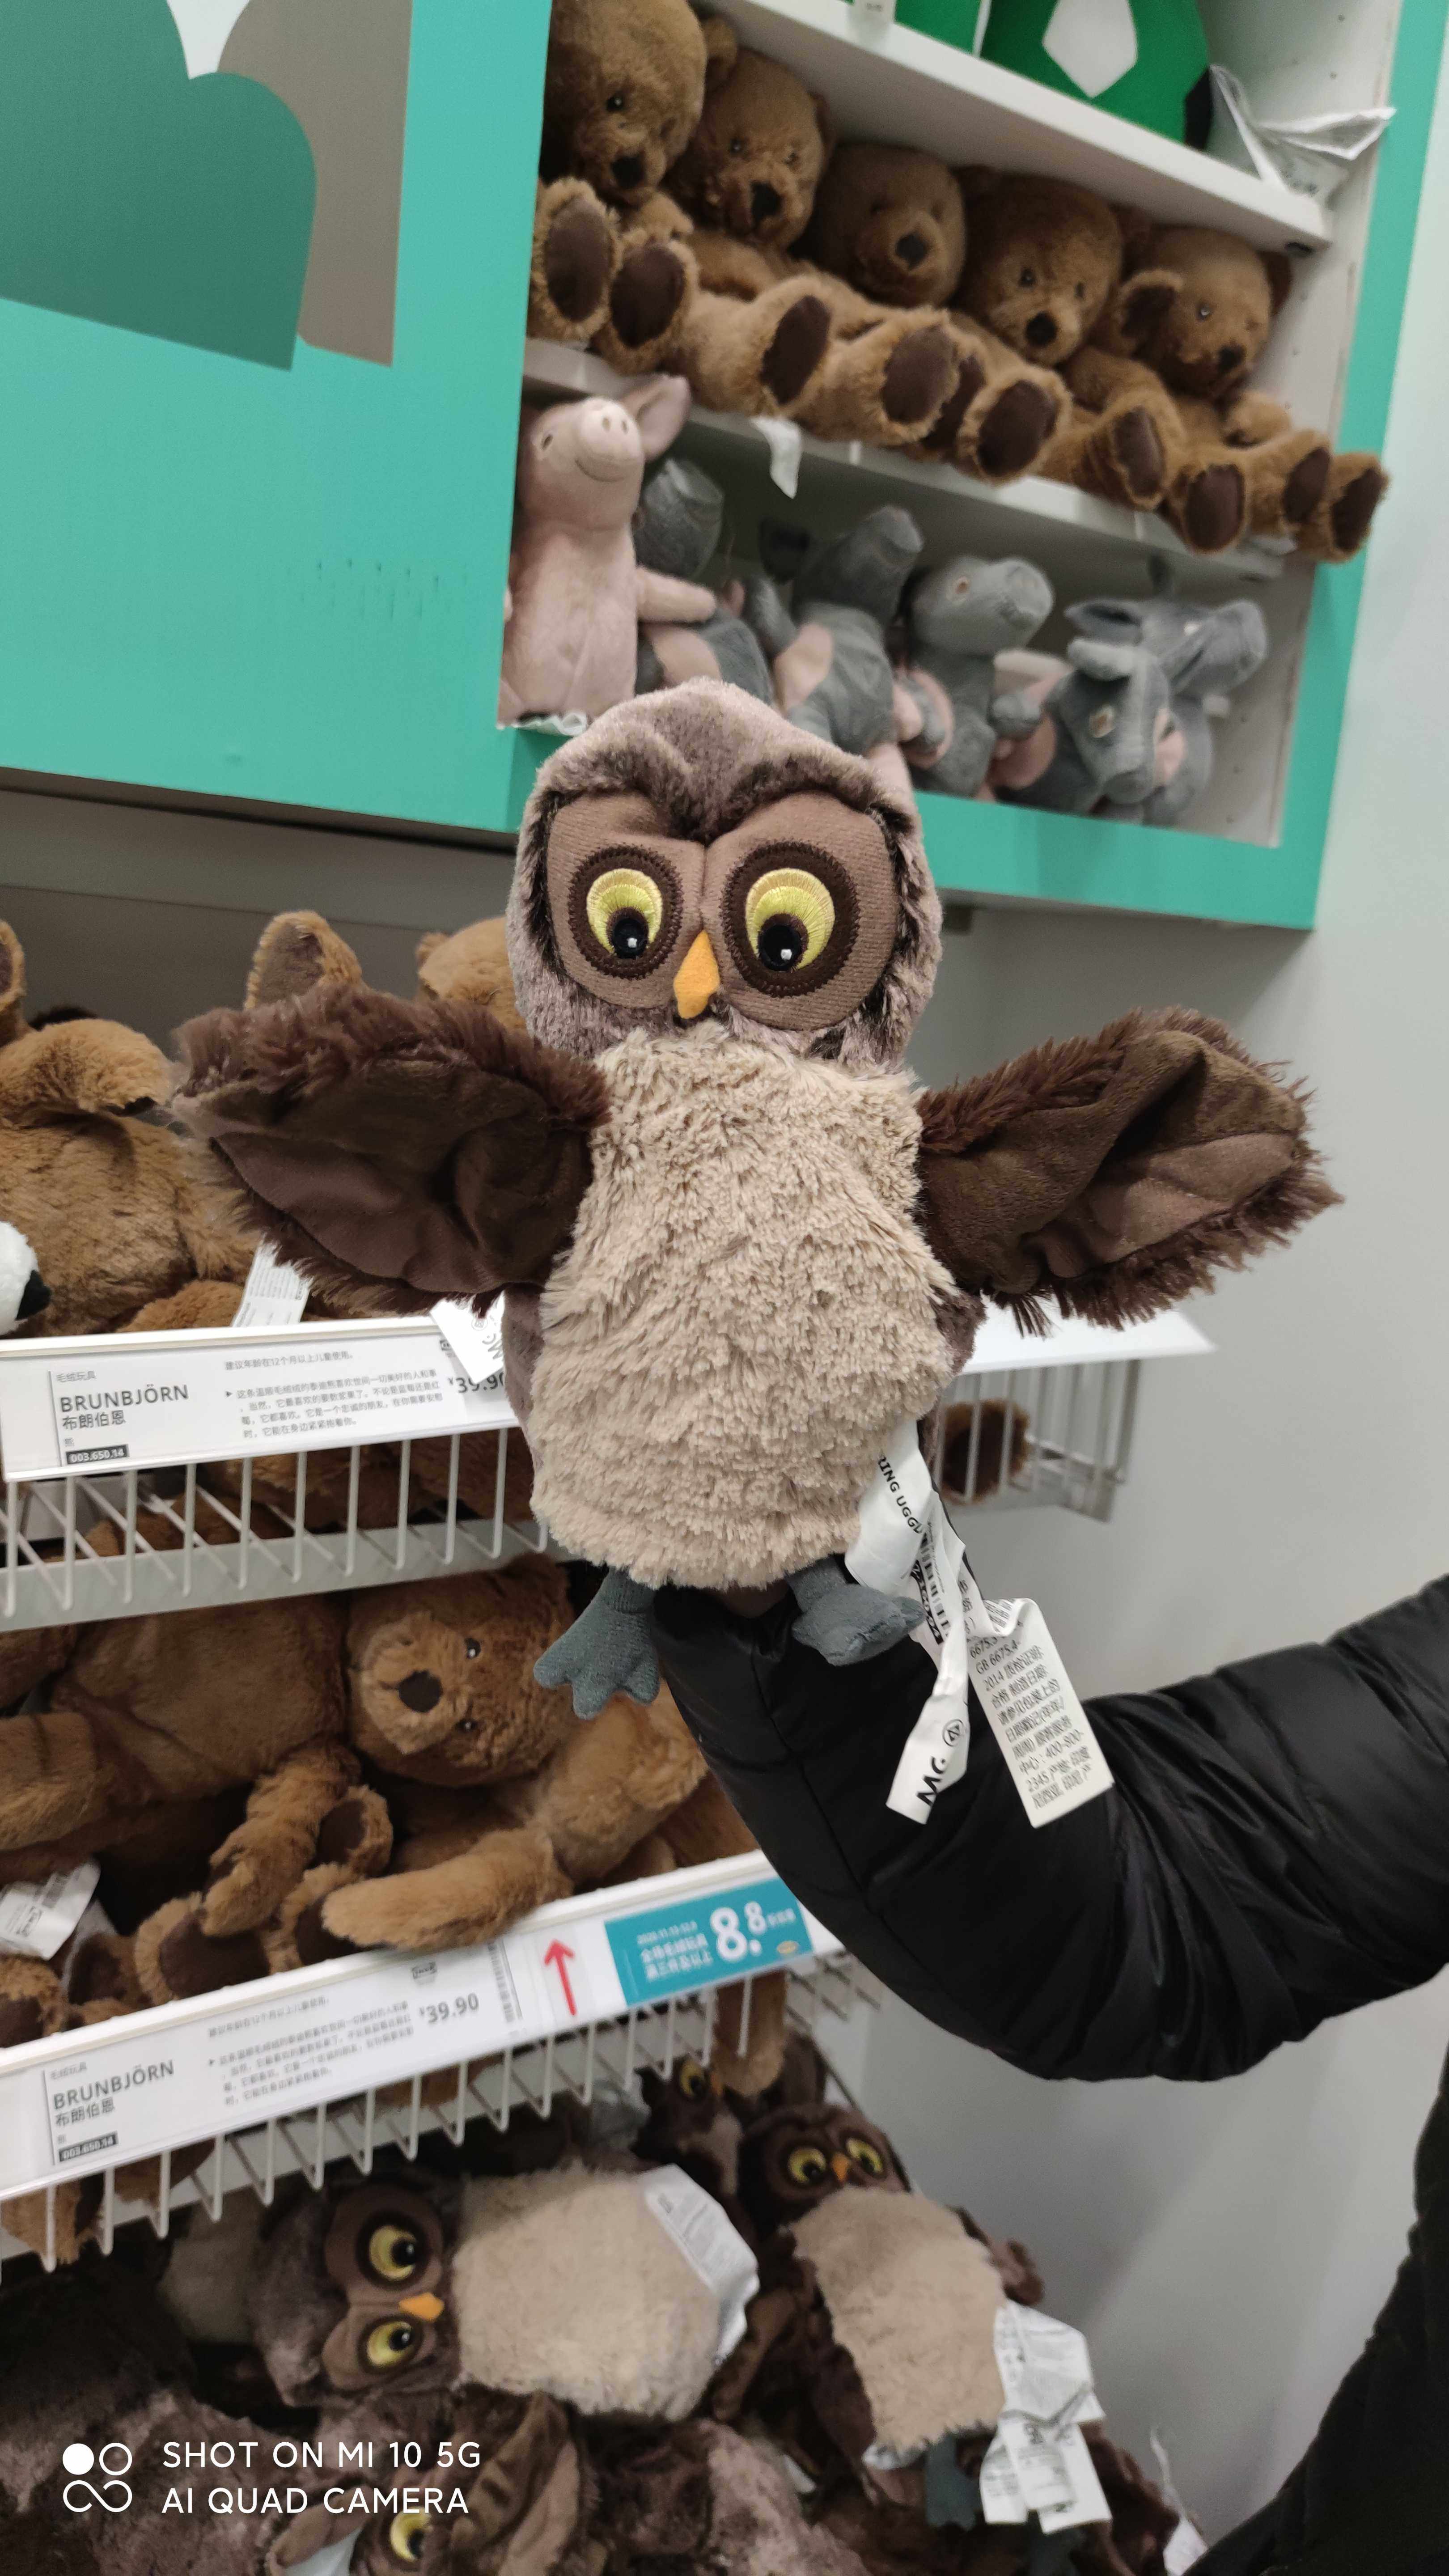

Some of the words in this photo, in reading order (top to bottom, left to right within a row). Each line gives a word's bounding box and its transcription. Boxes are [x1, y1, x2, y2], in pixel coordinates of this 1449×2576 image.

[61, 1384, 189, 1412] BRUNBJÖRN
[63, 1410, 126, 1430] 布朗伯恩
[70, 1448, 124, 1463] 003.650.14
[976, 1659, 990, 1674] GB
[54, 2059, 174, 2109] BRUNBJÖRN
